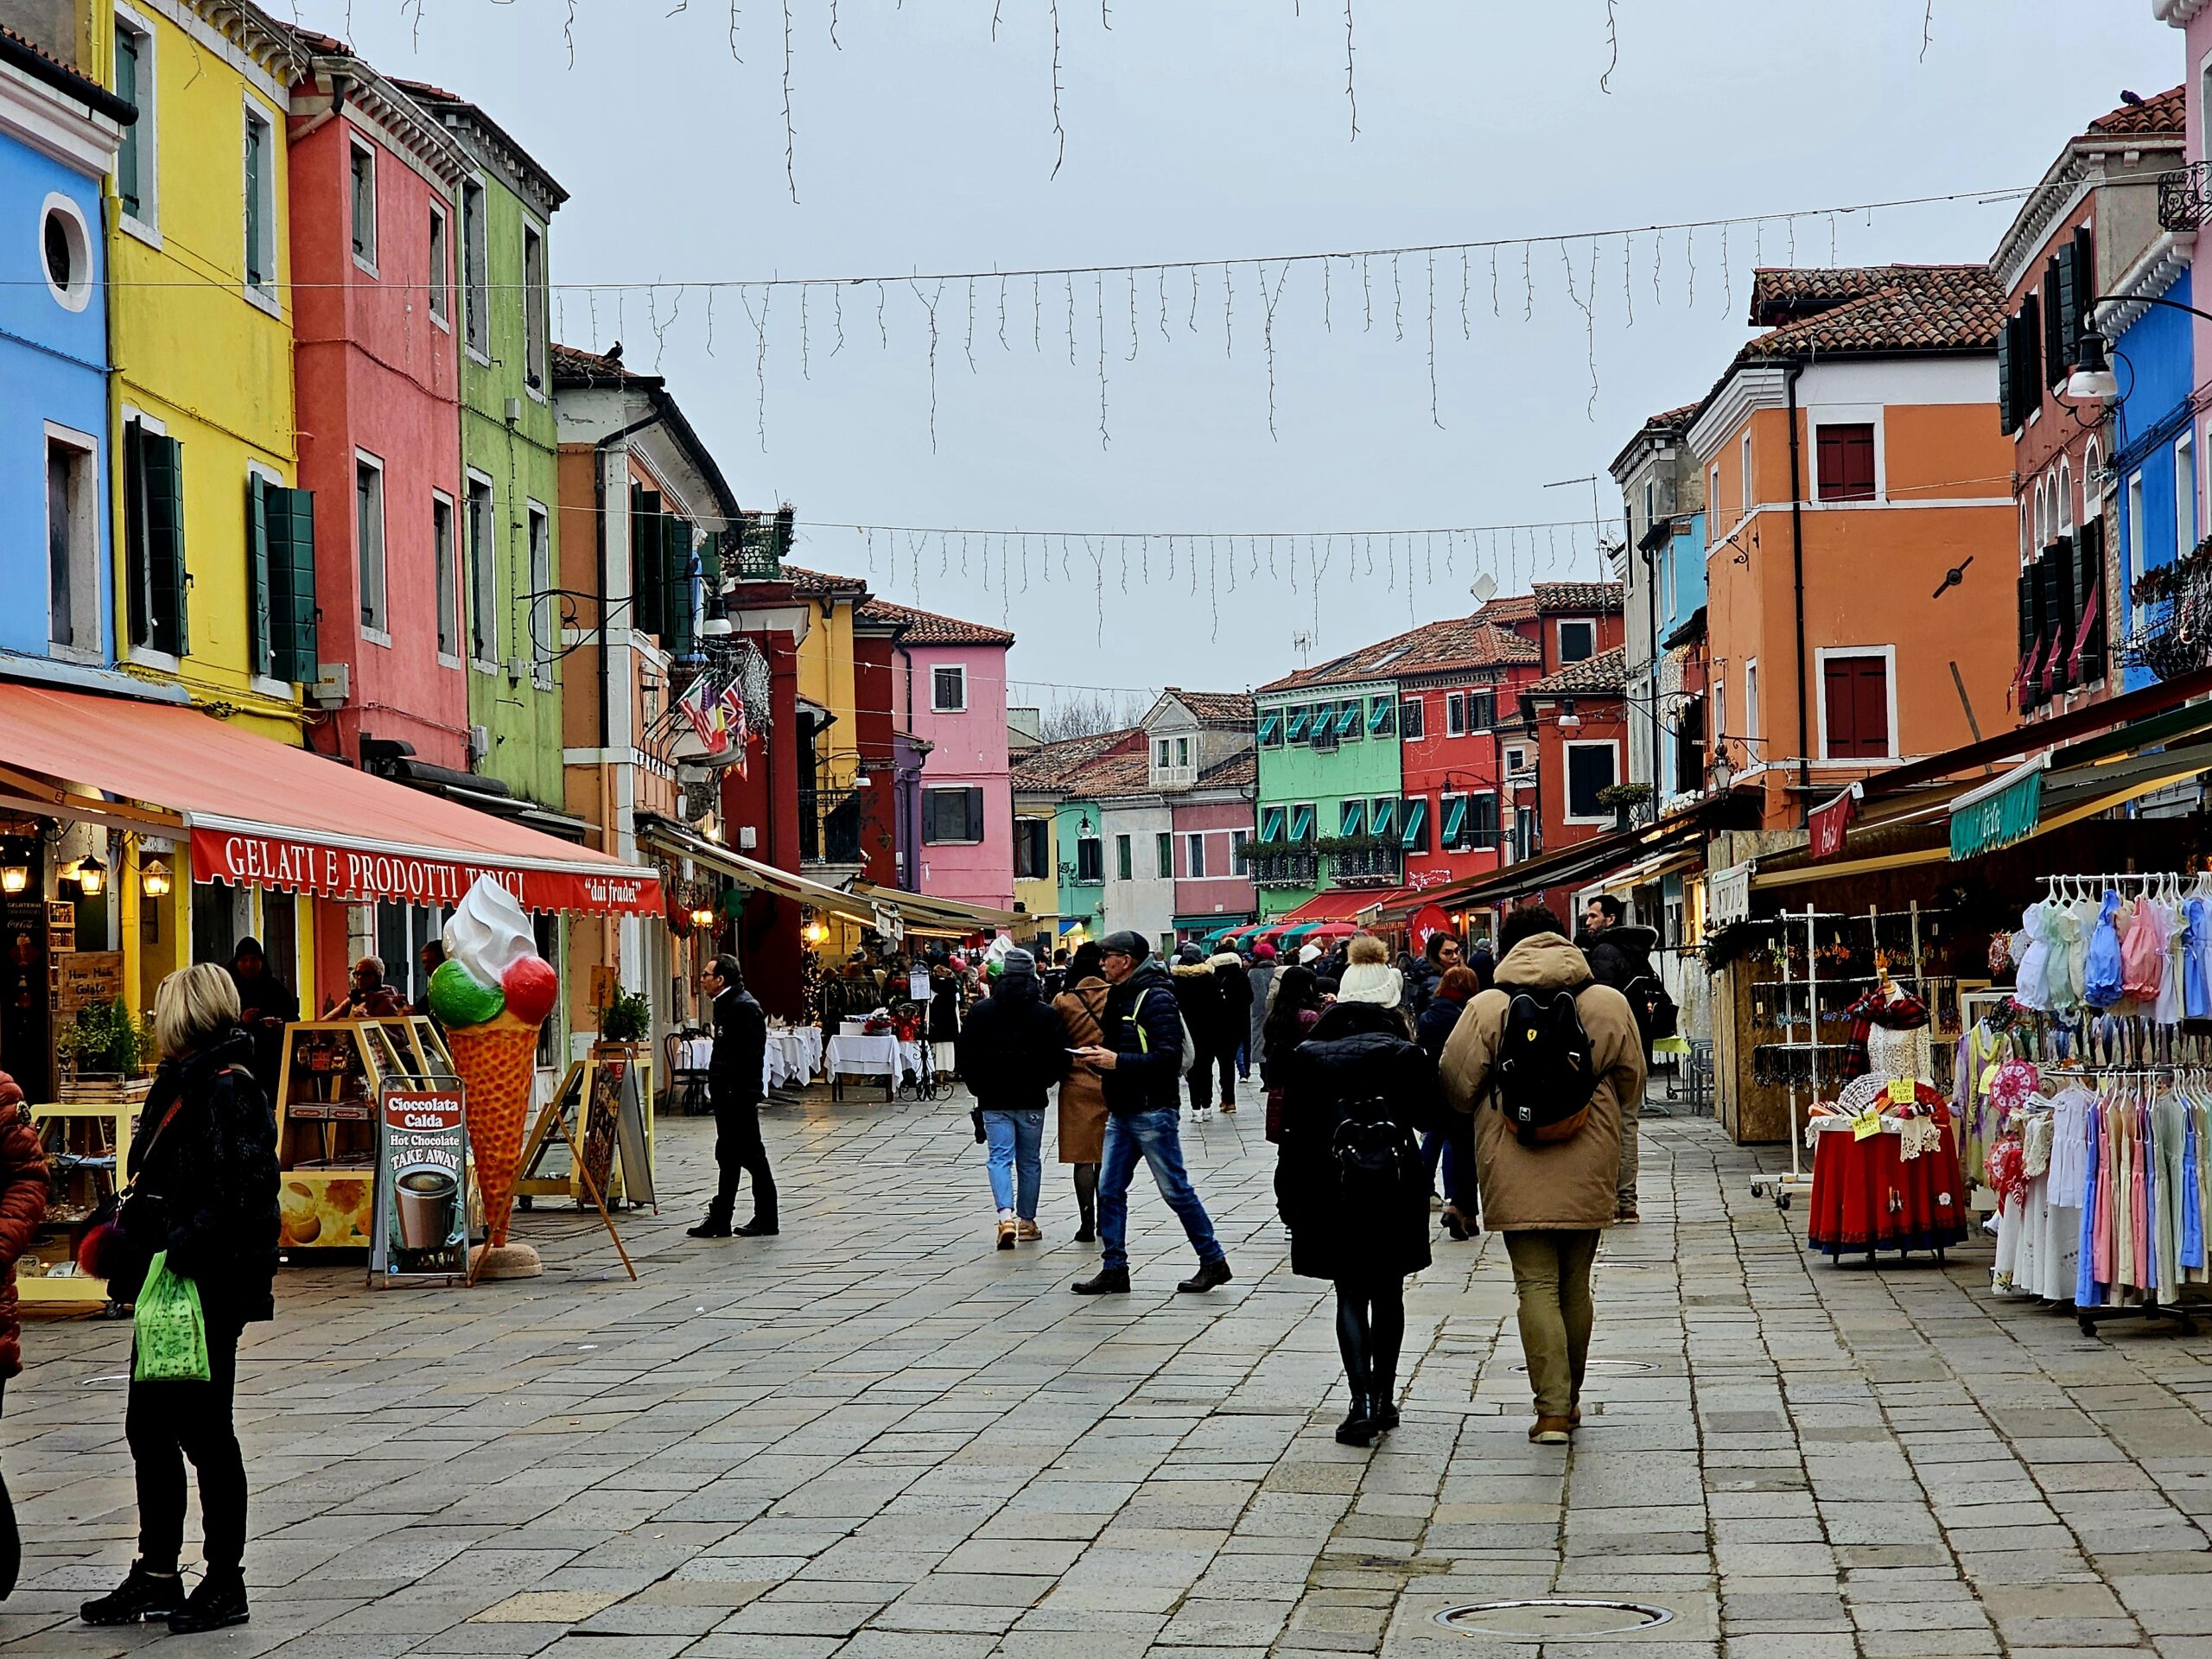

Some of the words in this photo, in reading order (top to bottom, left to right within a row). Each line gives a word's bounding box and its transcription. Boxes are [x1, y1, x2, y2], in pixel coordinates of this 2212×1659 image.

[225, 836, 316, 883] GELATI
[325, 849, 340, 887] E
[346, 853, 459, 899] PRODOTTI
[75, 983, 106, 995] Gelato
[388, 1097, 459, 1112] Cioccolata
[404, 1113, 443, 1128] Calda
[390, 1135, 410, 1147] Hot
[410, 1135, 460, 1147] Chocolate
[390, 1148, 424, 1172] TAKE
[425, 1148, 461, 1171] AWAY
